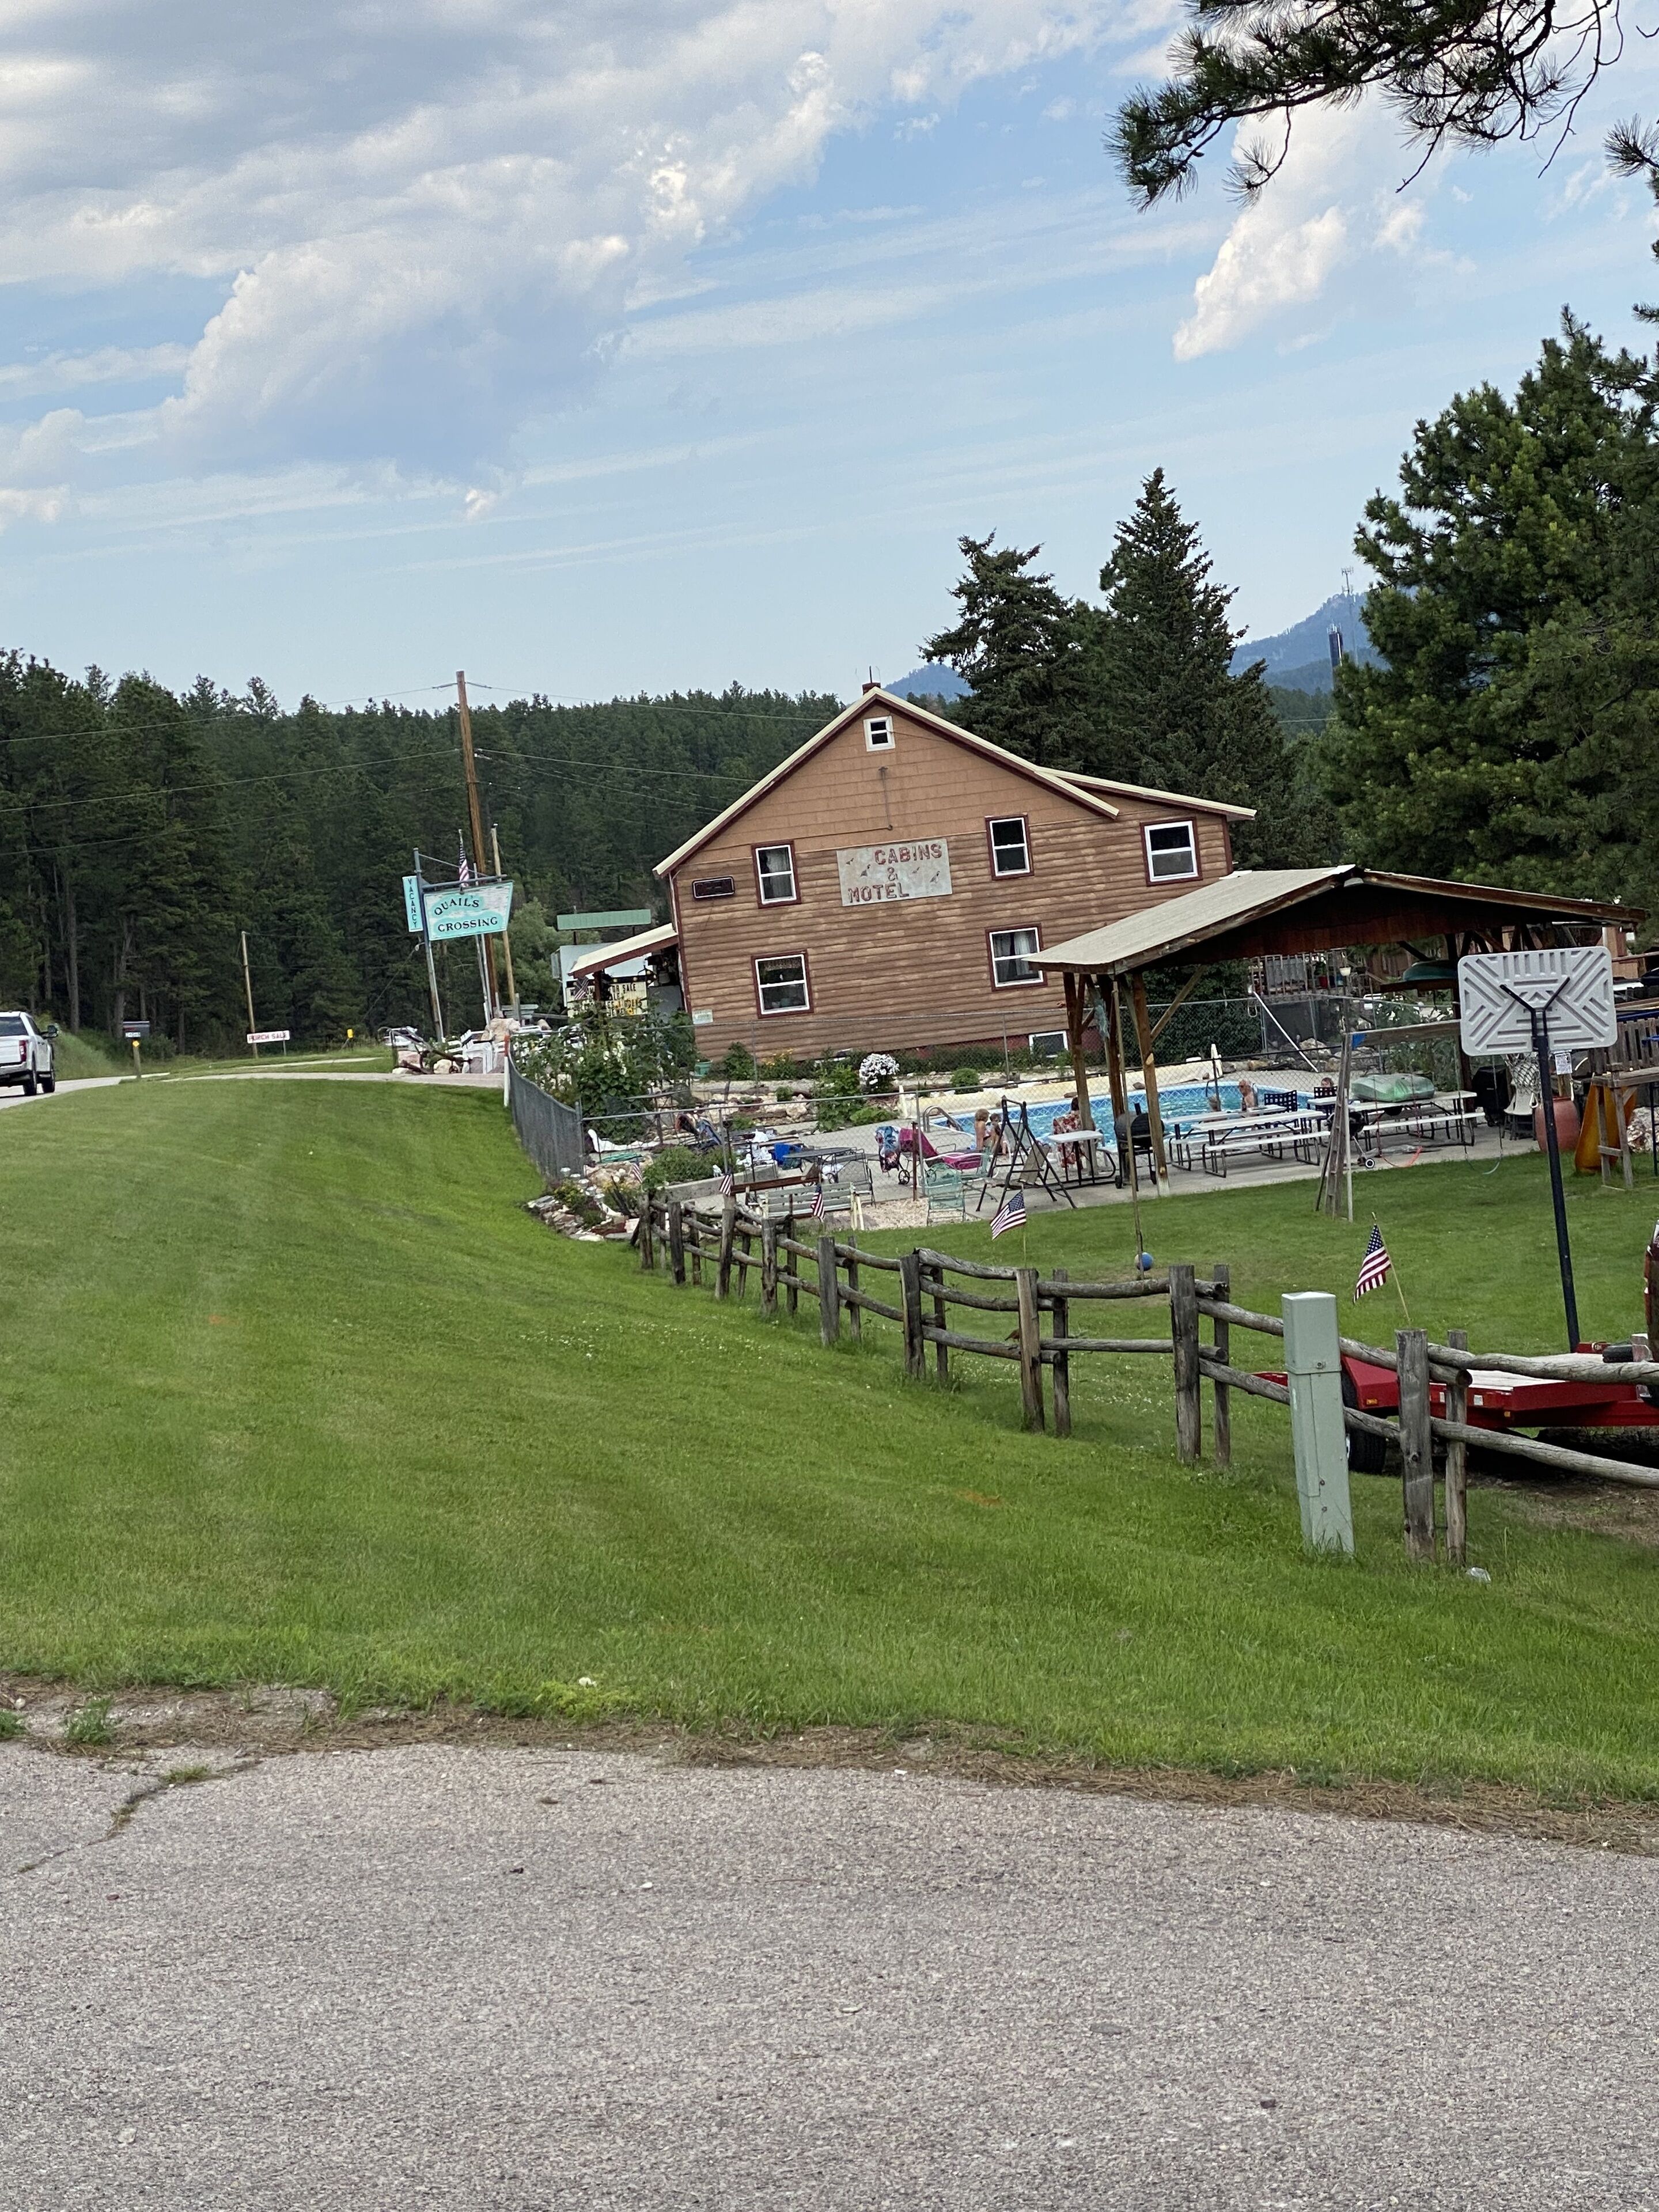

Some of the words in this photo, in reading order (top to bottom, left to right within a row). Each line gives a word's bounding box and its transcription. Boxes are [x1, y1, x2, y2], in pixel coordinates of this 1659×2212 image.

[874, 843, 942, 865] CABINS
[887, 866, 899, 881] &
[407, 878, 417, 928] VACANCY
[847, 882, 910, 903] MOTEL
[434, 895, 479, 916] QUAIL'S
[437, 916, 498, 932] CROSSING
[622, 983, 637, 991] SALE
